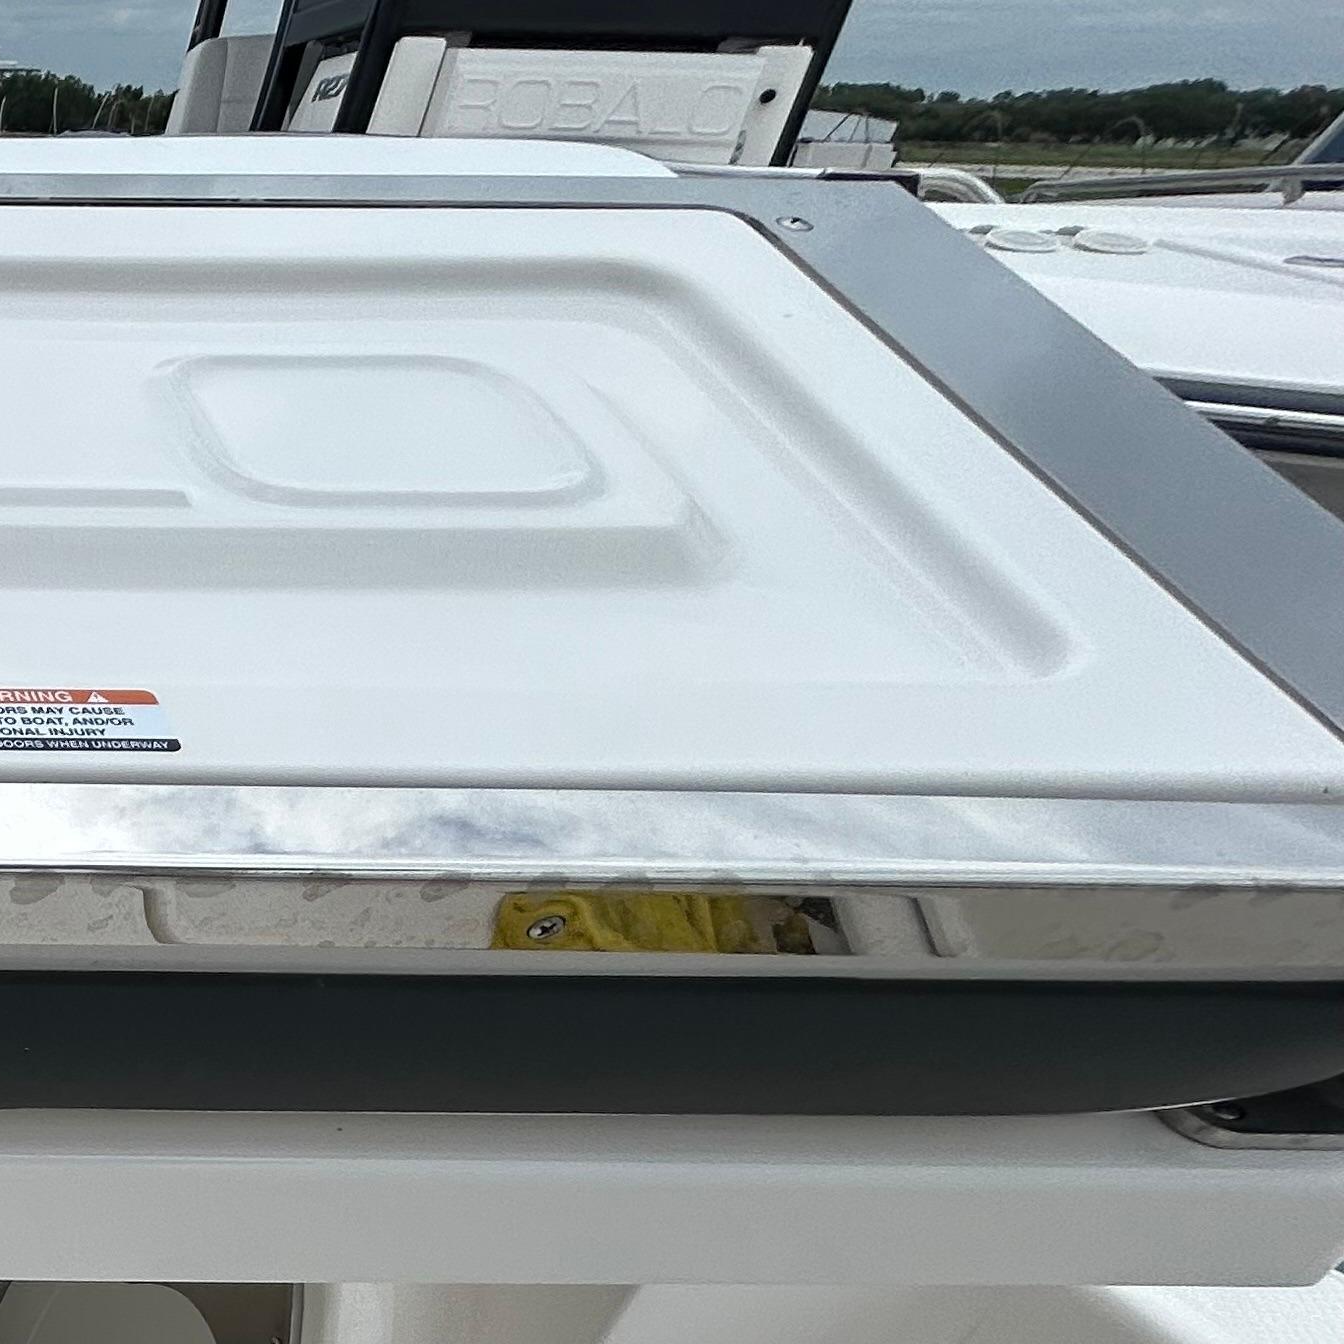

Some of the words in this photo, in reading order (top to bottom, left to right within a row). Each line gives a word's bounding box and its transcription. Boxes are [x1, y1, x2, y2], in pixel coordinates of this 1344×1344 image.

[453, 77, 749, 136] ROBALO
[31, 706, 64, 715] MAY
[68, 706, 126, 716] CAUSE
[21, 717, 69, 727] BOAT,
[72, 717, 135, 727] AND/OR
[49, 727, 107, 737] INJURY
[46, 740, 90, 749] WHEN
[92, 740, 169, 750] UNDERWAY
